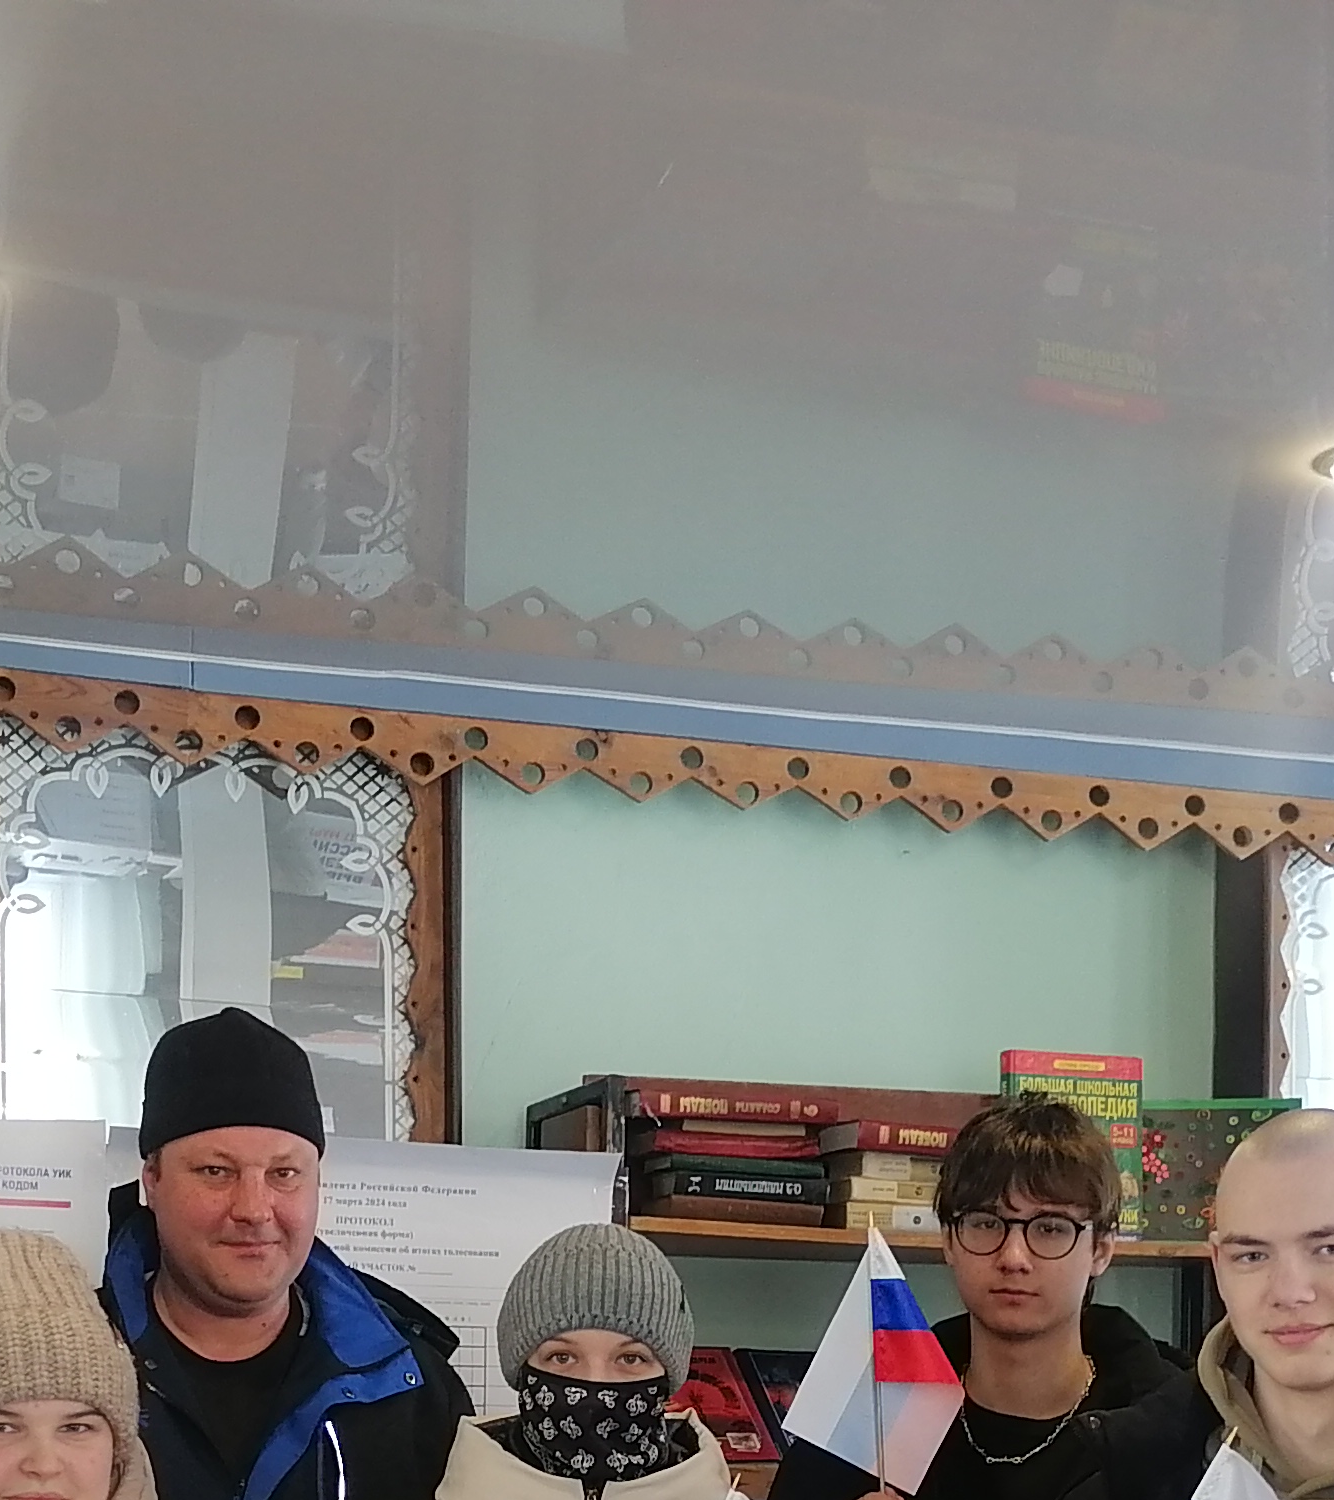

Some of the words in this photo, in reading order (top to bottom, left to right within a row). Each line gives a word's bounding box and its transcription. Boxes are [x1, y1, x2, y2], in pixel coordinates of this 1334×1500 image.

[1018, 1076, 1074, 1094] БОЛЬШАЯ
[1076, 1081, 1138, 1097] ШКОЛЬНАЯ
[52, 1169, 72, 1179] УИК
[2, 1180, 39, 1191] КОДОМ
[360, 1182, 418, 1193] Российской
[421, 1184, 477, 1197] Федерации
[323, 1195, 334, 1205] 17
[336, 1198, 363, 1208] марта
[365, 1197, 386, 1207] 2024
[387, 1199, 408, 1209] года
[335, 1215, 395, 1228] ПРОТОКОЛ
[380, 1229, 415, 1241] форма)
[353, 1245, 398, 1254] комиссии
[399, 1245, 410, 1254] об
[361, 1262, 406, 1273] УЧАСТОК
